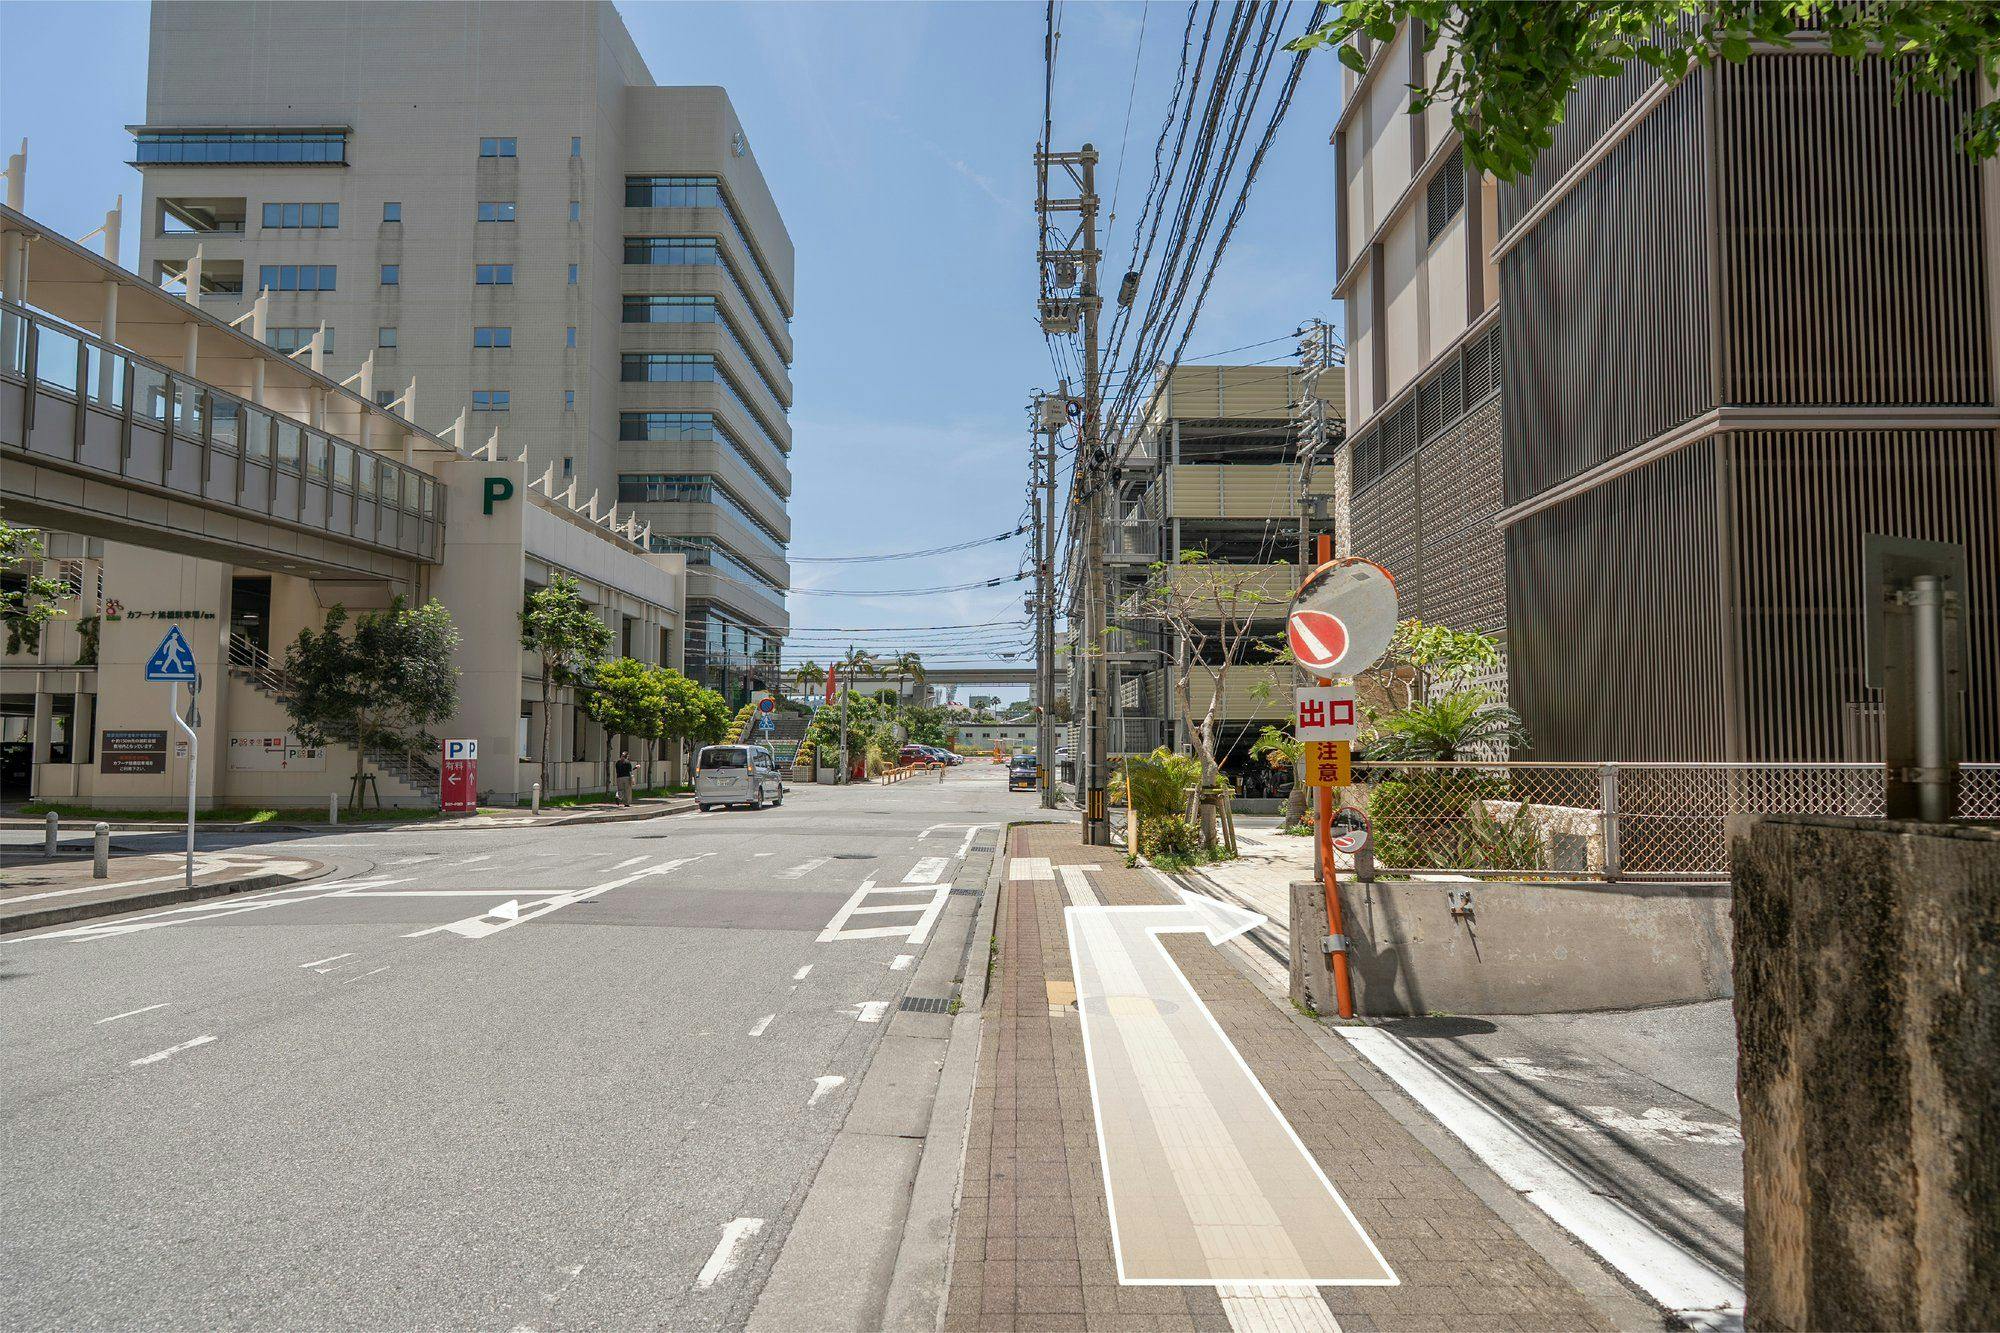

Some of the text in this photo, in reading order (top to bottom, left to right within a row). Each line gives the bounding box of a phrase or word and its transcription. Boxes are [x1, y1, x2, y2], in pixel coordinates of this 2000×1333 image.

[483, 477, 514, 515] P
[1299, 699, 1354, 728] 出口
[449, 741, 464, 758] P
[469, 741, 476, 758] P
[1317, 741, 1338, 782] 注意
